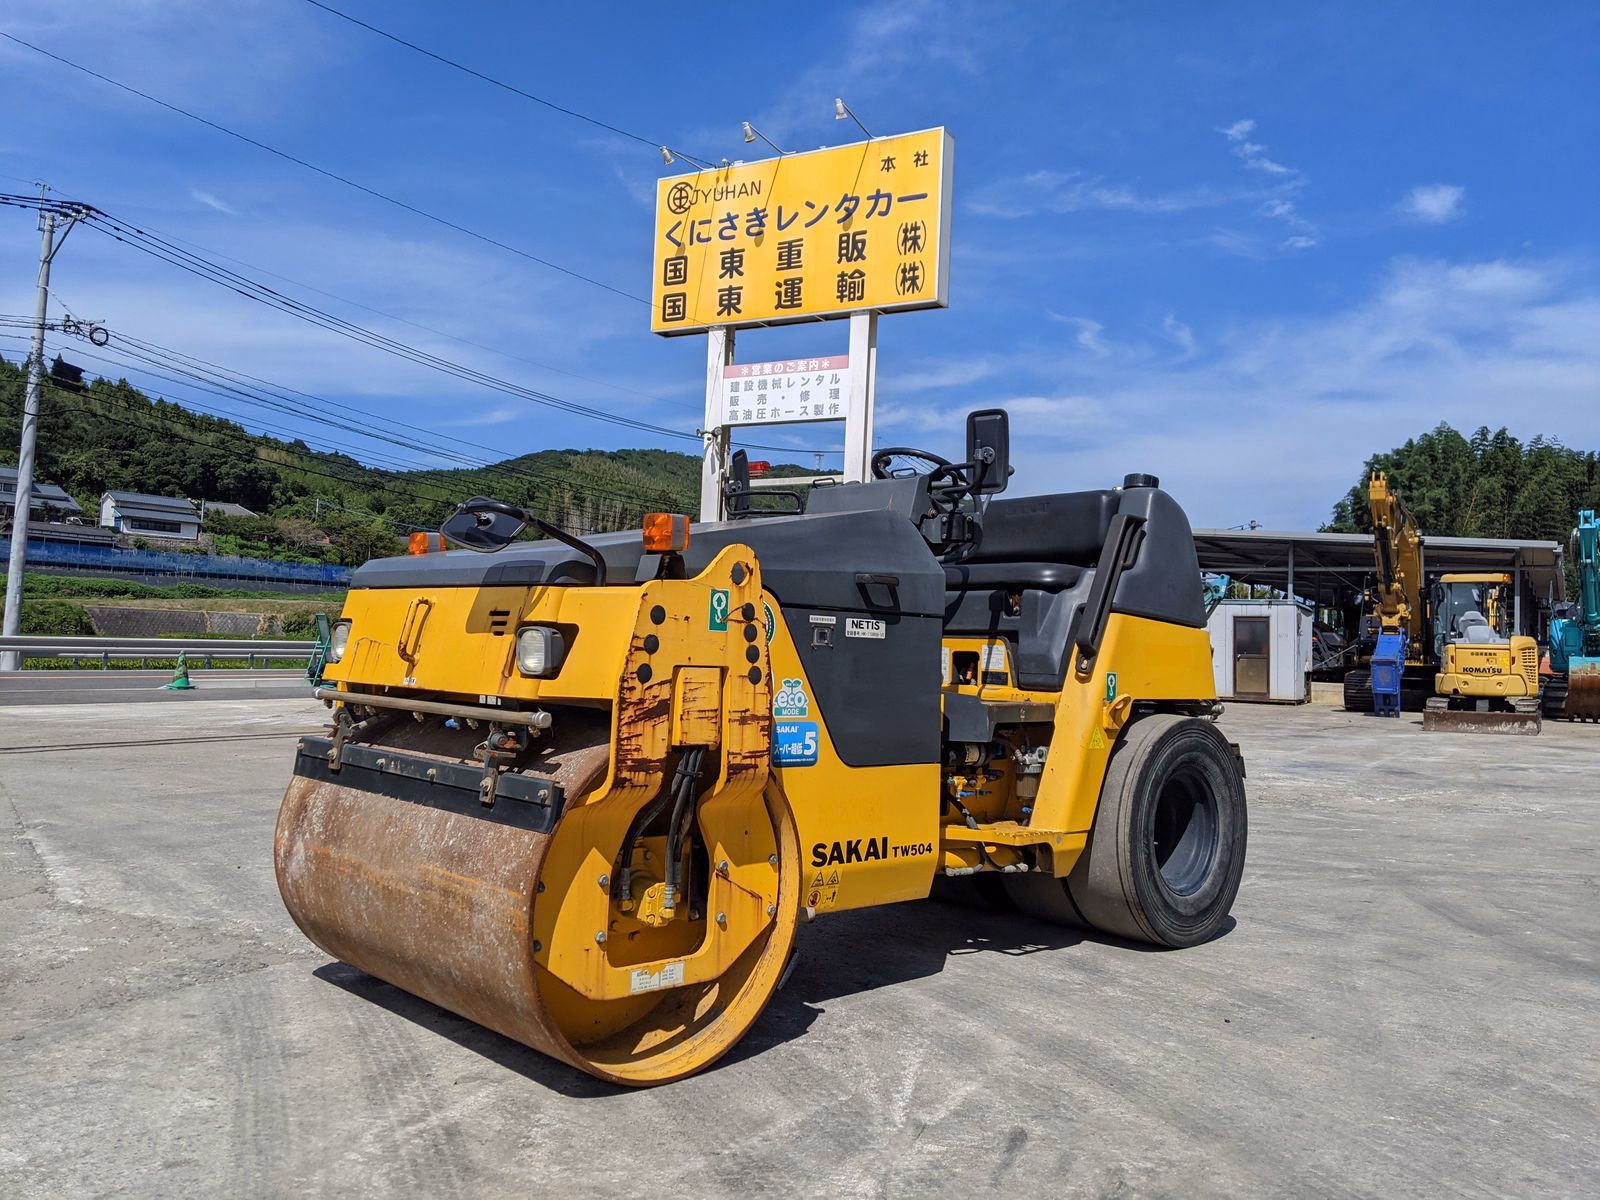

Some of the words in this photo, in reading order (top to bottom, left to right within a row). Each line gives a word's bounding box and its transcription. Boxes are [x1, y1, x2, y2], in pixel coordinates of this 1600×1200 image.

[880, 150, 929, 173] 本社
[665, 189, 928, 247] くにさきレンタカー
[730, 373, 841, 393] 建設機械レンタル
[728, 403, 840, 421] 高油圧ホース製作
[851, 620, 880, 630] NETIS
[1462, 666, 1502, 674] KOMATSU
[777, 690, 805, 708] eco
[781, 708, 800, 716] MODE
[775, 725, 798, 734] SAKAI
[811, 836, 888, 867] SAKAI
[892, 842, 933, 858] TW504
